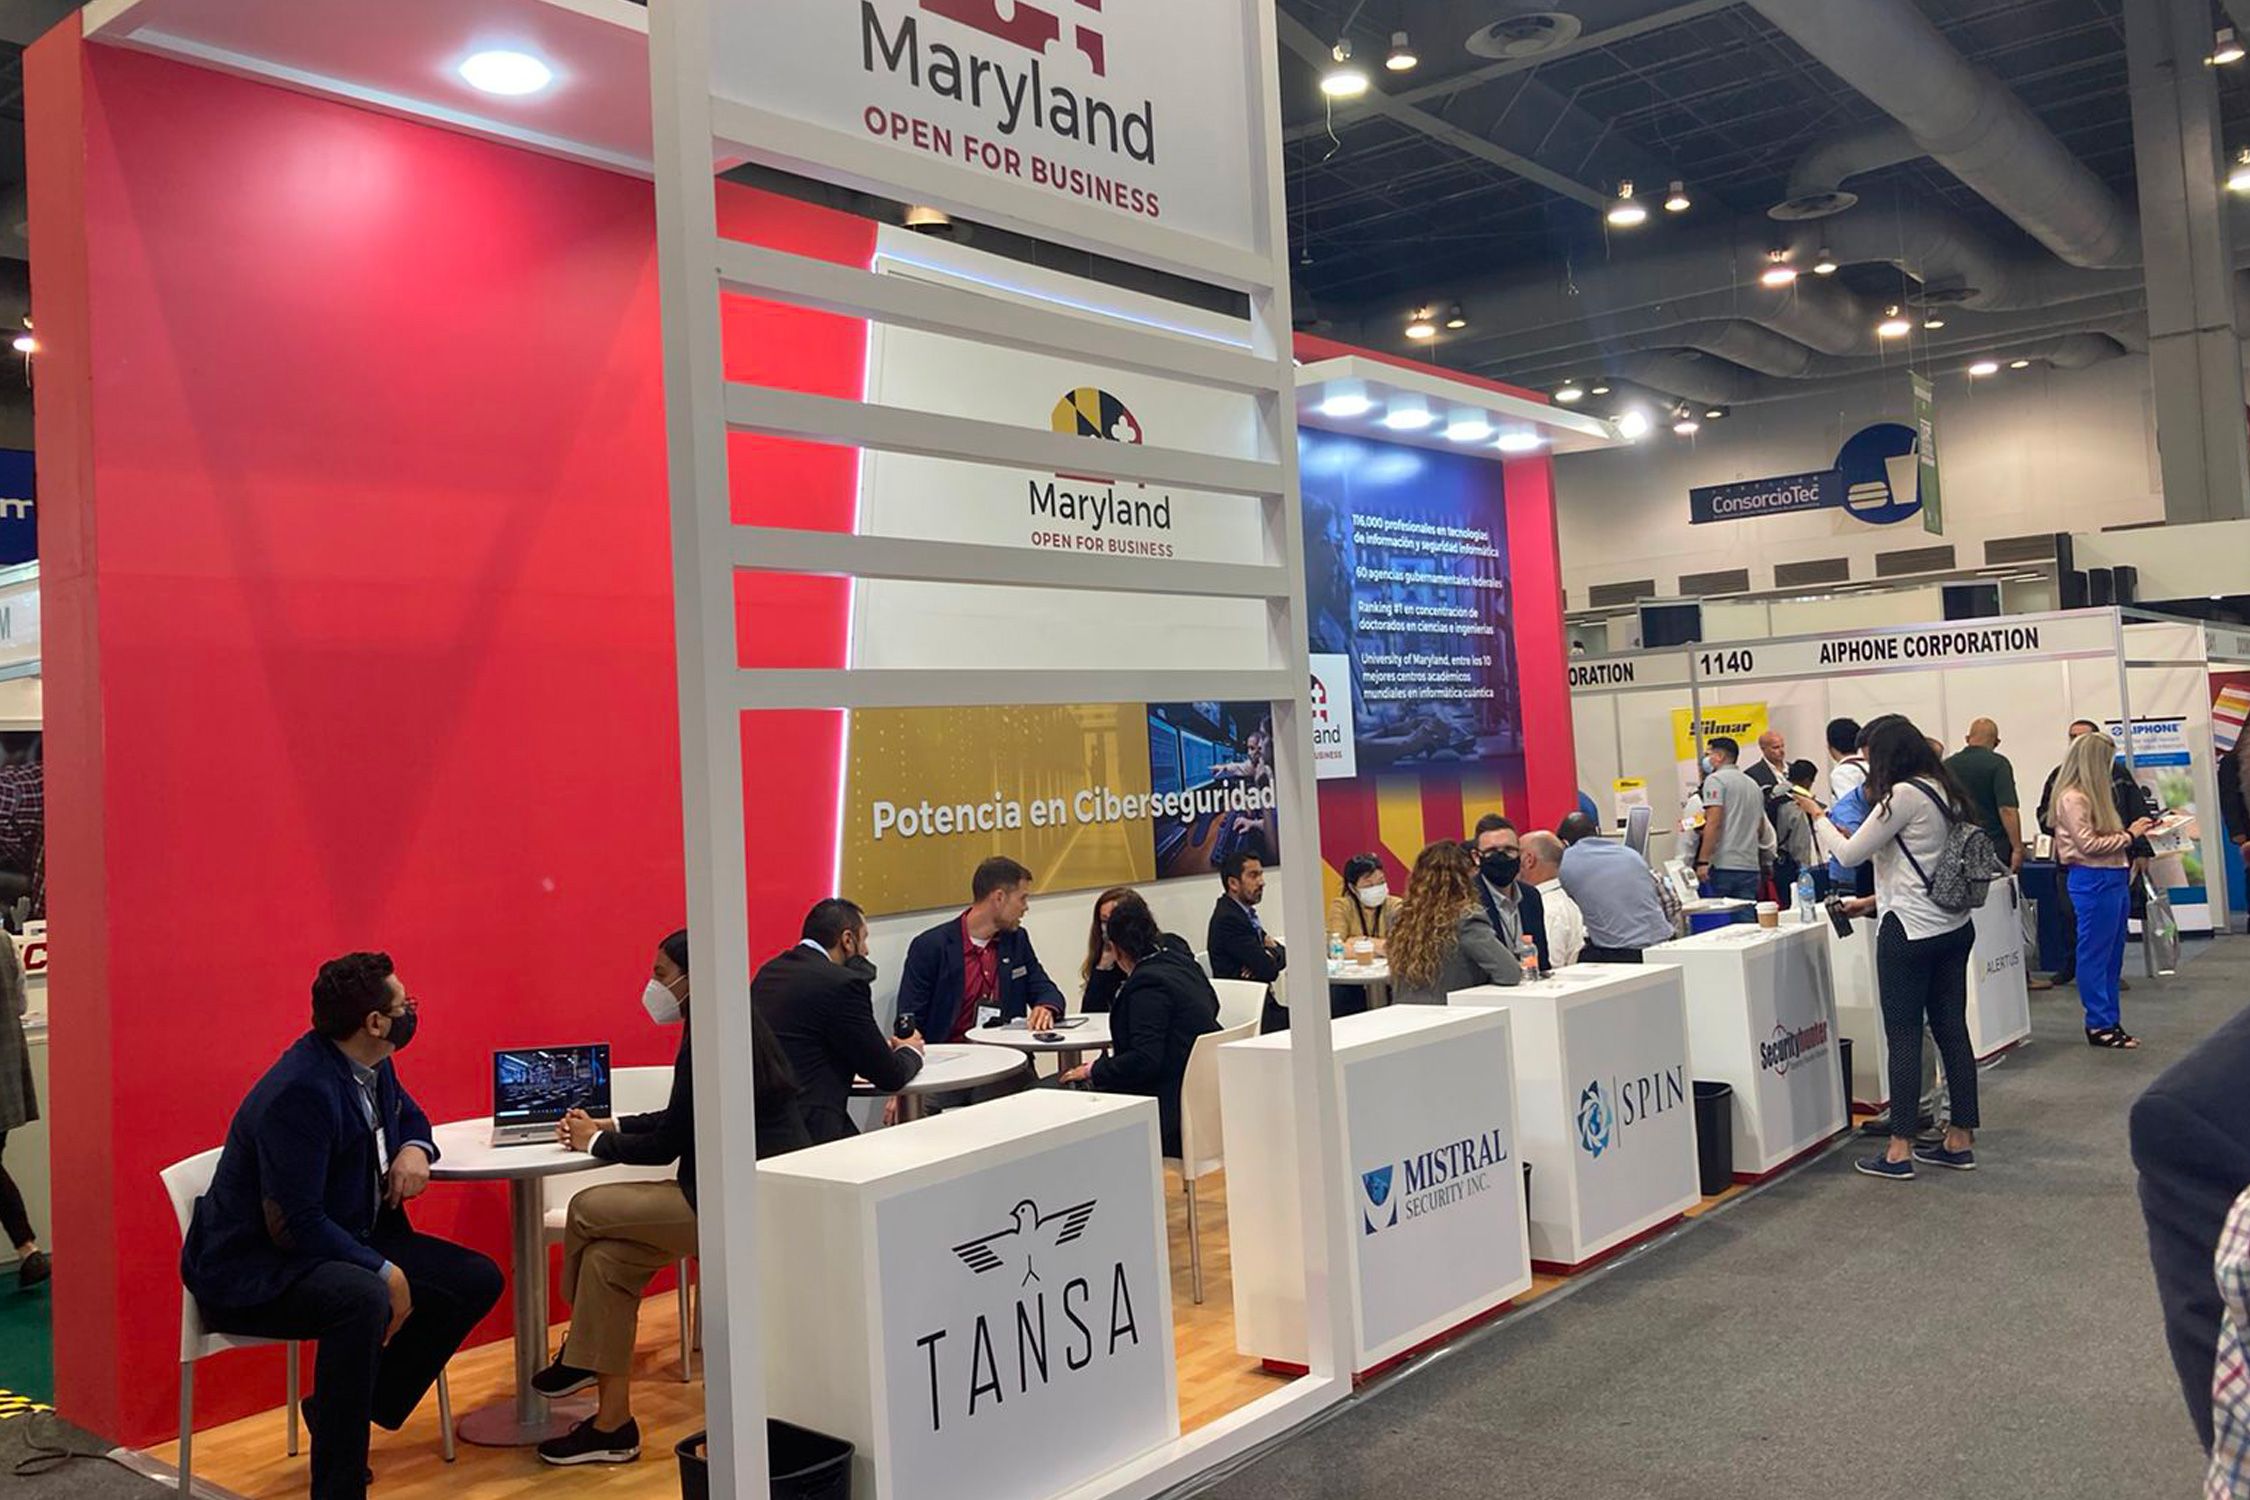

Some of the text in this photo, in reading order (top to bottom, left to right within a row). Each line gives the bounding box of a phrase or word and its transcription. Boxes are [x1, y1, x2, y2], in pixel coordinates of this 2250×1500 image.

[860, 0, 1156, 166] Maryland
[864, 106, 1161, 218] OPEN FOR BUSINESS
[1029, 480, 1171, 531] Maryland
[1712, 486, 1820, 514] ConsorcioTec
[1384, 519, 1436, 535] profesionales
[1436, 526, 1447, 536] en
[1031, 532, 1174, 558] OPEN FOR BUSINESS
[1353, 531, 1365, 544] de
[1421, 540, 1459, 554] seguridad
[1355, 566, 1503, 588] 60 agencias gubernamentales federales
[1358, 601, 1393, 617] Ranking
[1404, 604, 1414, 614] en
[1468, 606, 1479, 618] de
[1358, 618, 1405, 631] doctorados
[1406, 620, 1417, 631] en
[1417, 620, 1448, 633] ciencias
[1361, 653, 1402, 667] University
[1403, 654, 1412, 665] of
[1451, 656, 1472, 666] entre
[1472, 655, 1483, 666] los
[1482, 655, 1492, 666] 10
[1819, 627, 2039, 665] AIPHONE CORPORATION
[1362, 670, 1396, 684] mejores
[1397, 670, 1427, 682] centros
[1700, 649, 1753, 677] 1140
[1364, 687, 1407, 699] mundiales
[1407, 688, 1418, 699] en
[873, 779, 1276, 839] Potencia en Ciberseguridad
[1986, 950, 2020, 975] ALERTUS
[1622, 1064, 1684, 1126] SPIN
[1403, 1128, 1508, 1196] MISTRAL
[1405, 1173, 1491, 1221] SECURITY INC.
[916, 1261, 1139, 1431] TANSA
